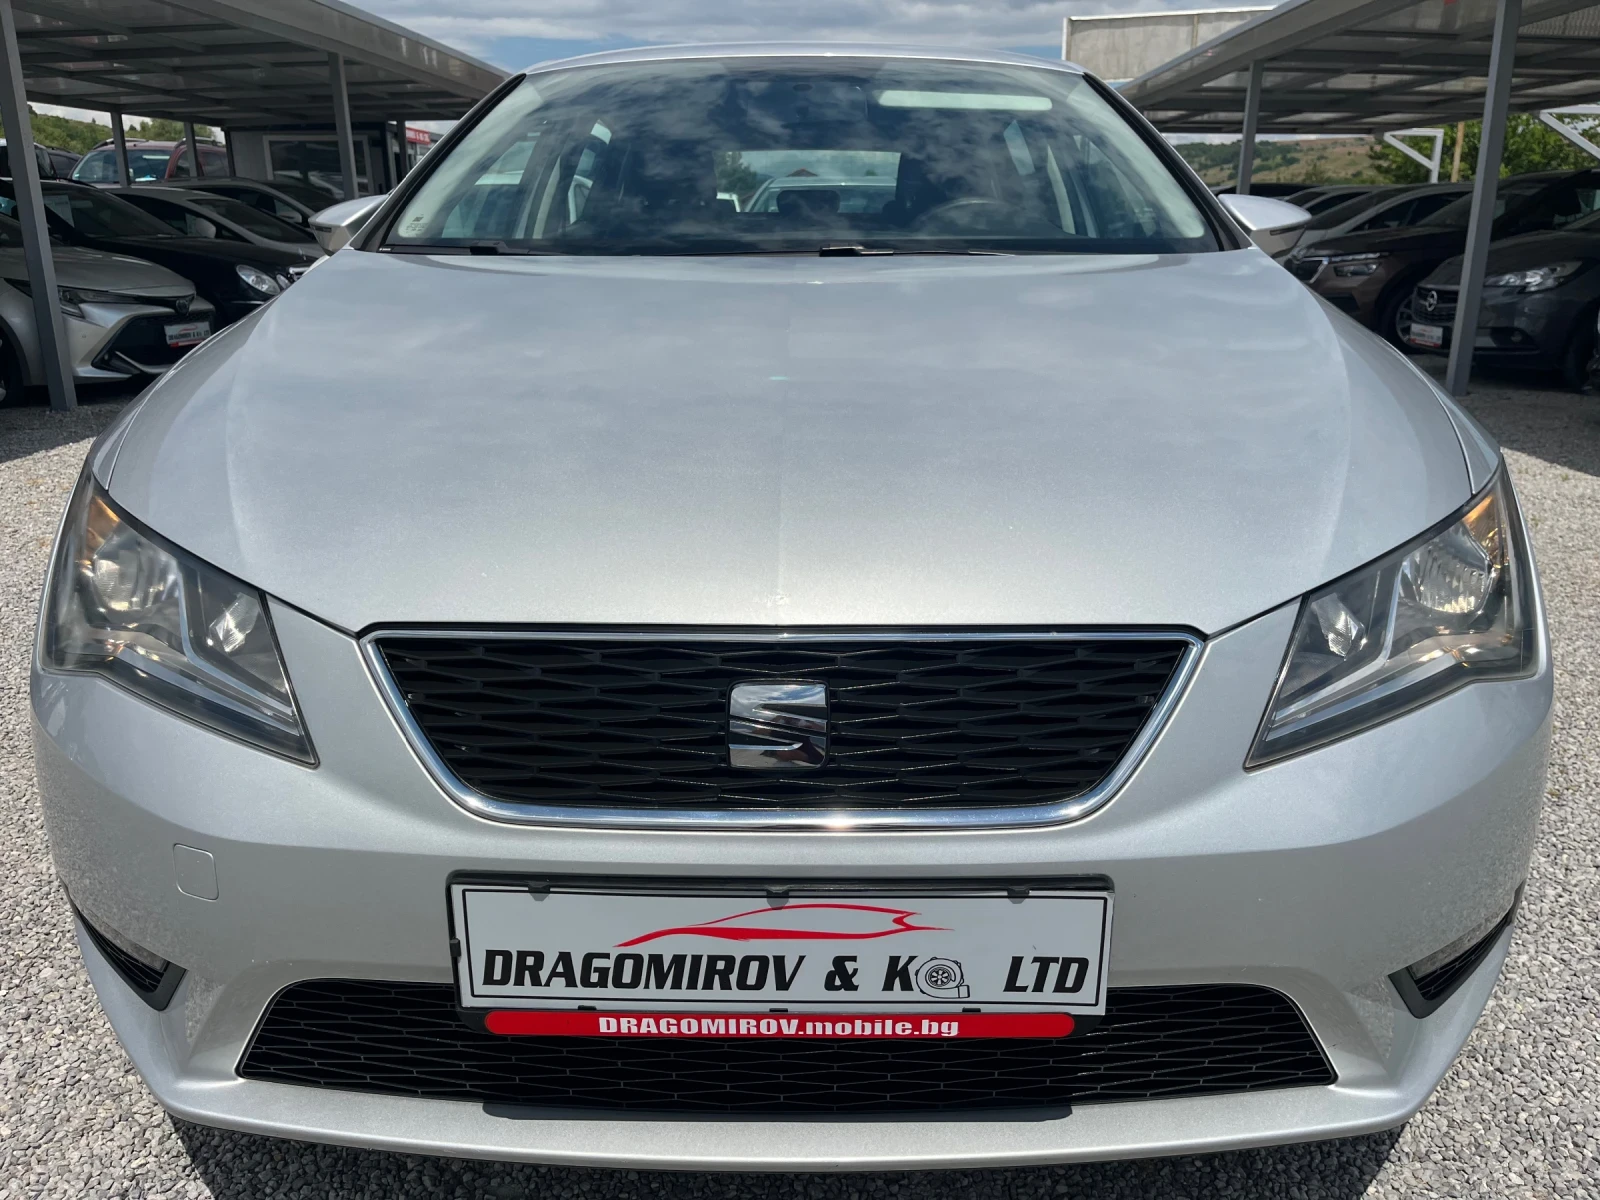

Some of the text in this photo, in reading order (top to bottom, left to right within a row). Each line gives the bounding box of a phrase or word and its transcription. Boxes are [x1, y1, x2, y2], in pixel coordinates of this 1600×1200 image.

[482, 949, 806, 992] DRAGOMIROV
[824, 955, 859, 992] &
[1003, 956, 1090, 994] LTD
[598, 1017, 960, 1037] DRAGOMIROV.mobile.bg
